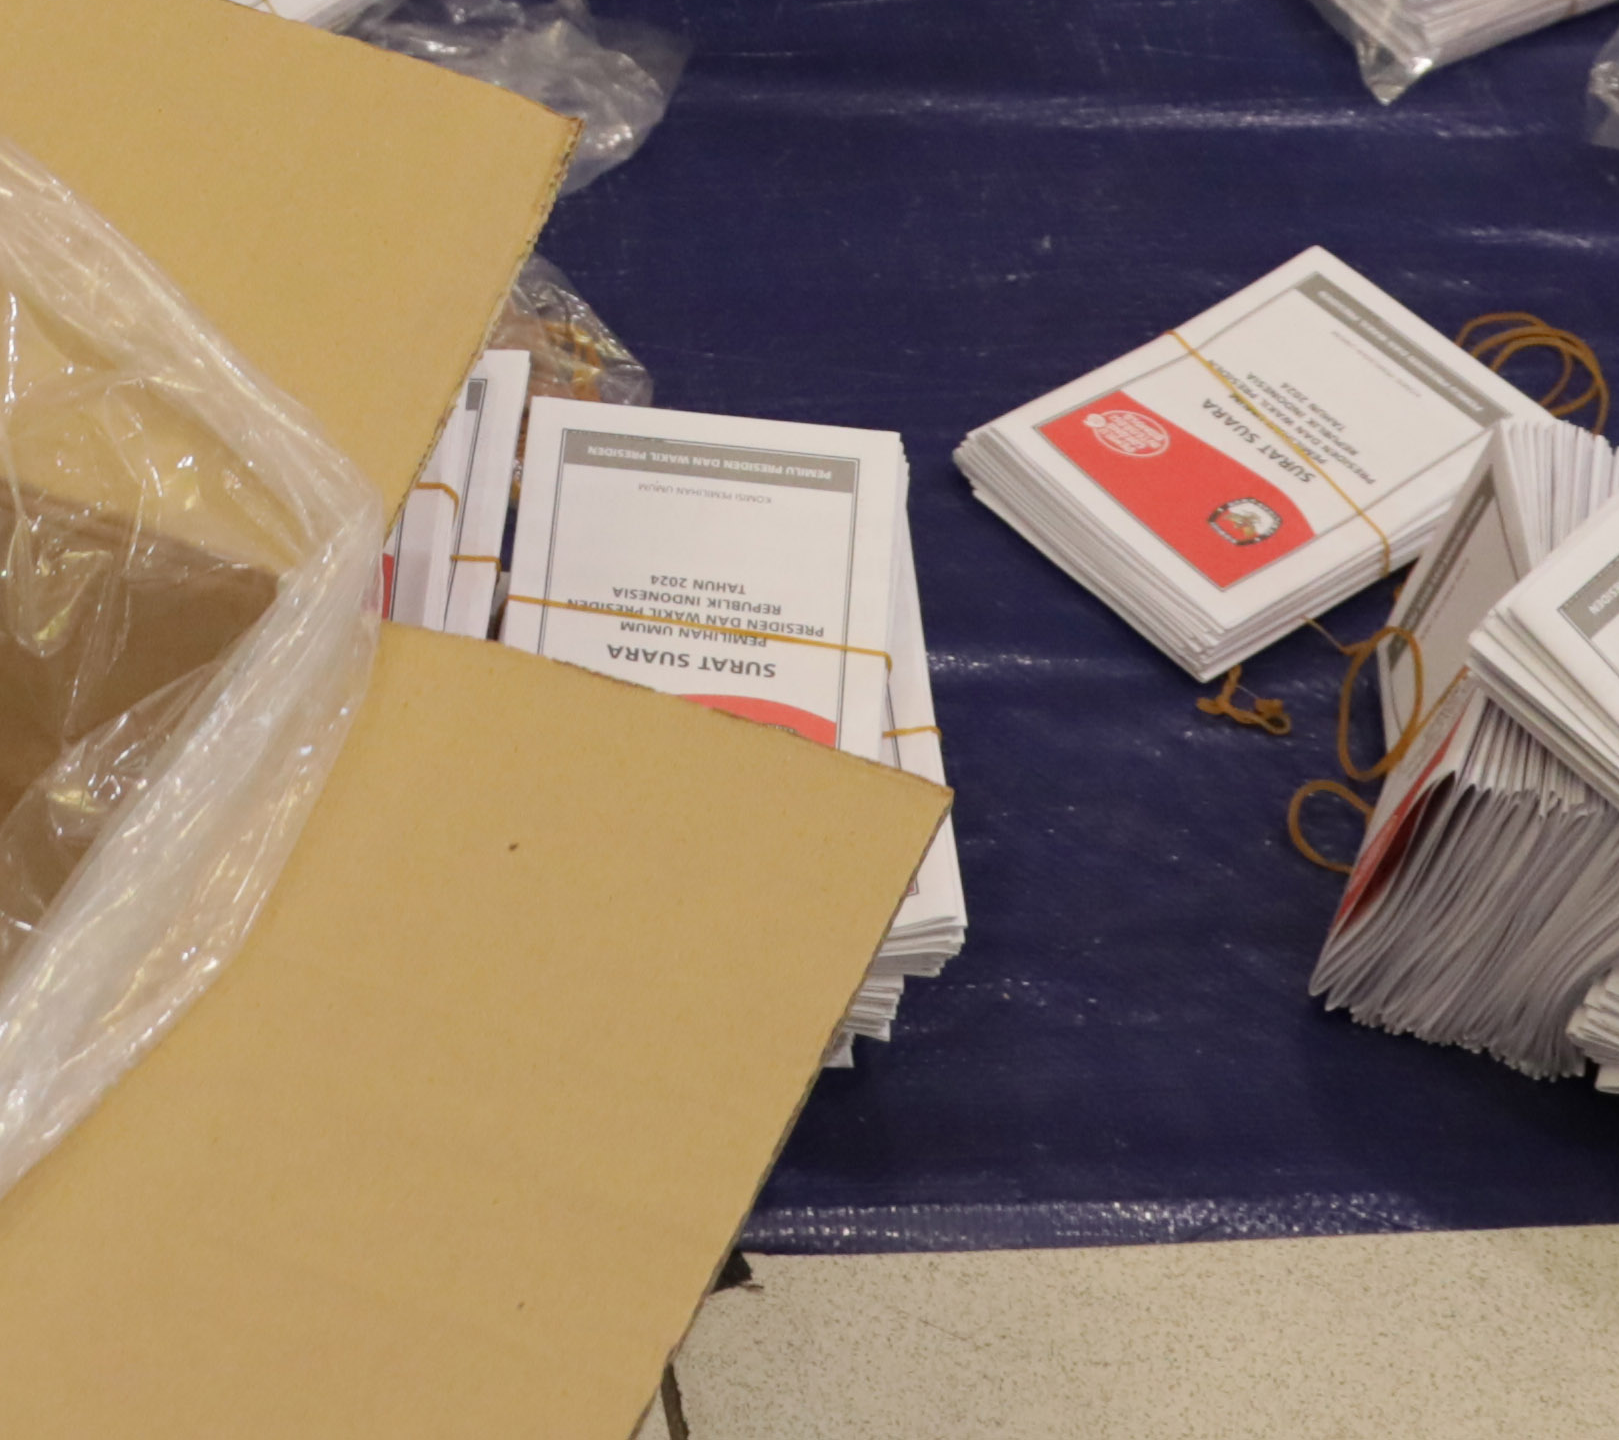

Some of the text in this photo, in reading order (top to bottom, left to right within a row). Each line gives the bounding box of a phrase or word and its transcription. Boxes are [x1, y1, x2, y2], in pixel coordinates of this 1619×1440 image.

[1203, 398, 1316, 482] SURAT SUARA
[588, 446, 832, 479] PEMILU PRESIDEN DAN WAKIL PRESIDEN
[638, 482, 772, 503] KOMISI PEMILIHAN UMUM
[650, 574, 745, 595] TAHUN 2024
[612, 586, 781, 615] REPUBLIK INDONESIA
[566, 598, 824, 637] PRESIDEN DAN WAKIL PRESIDEN
[620, 621, 767, 647] PEMILIHAN UMUM
[607, 644, 776, 678] SURAT SUARA
